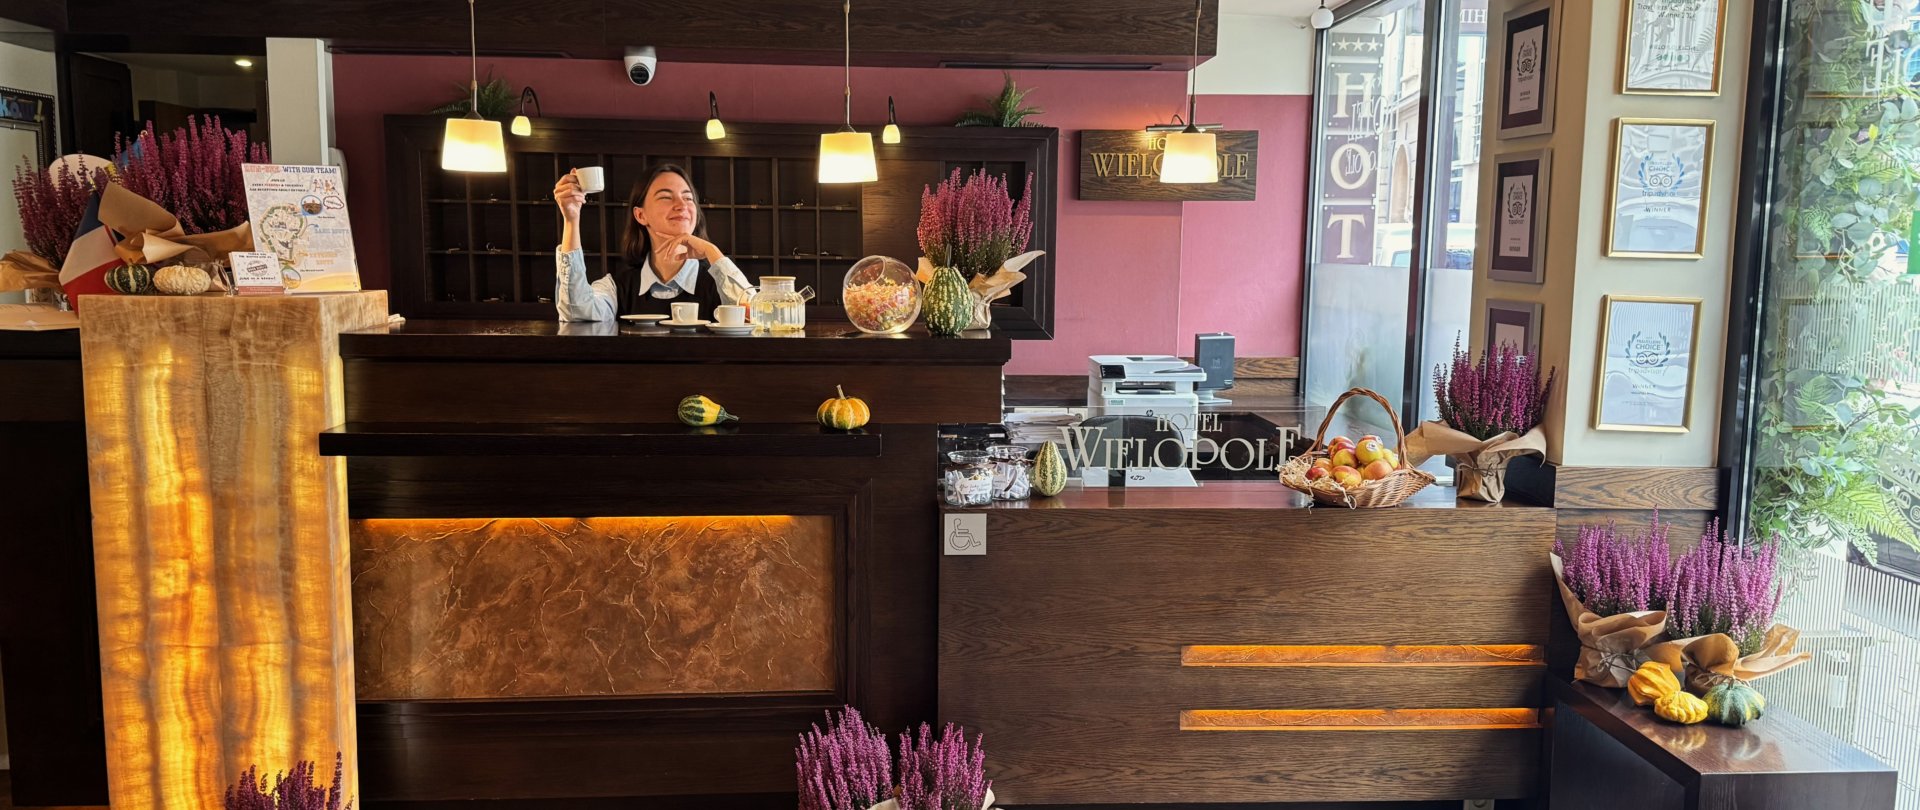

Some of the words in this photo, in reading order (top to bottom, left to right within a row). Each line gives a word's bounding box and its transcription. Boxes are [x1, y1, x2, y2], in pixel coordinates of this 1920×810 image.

[316, 166, 337, 174] TEAM!
[1635, 343, 1661, 351] CHOICE
[1154, 412, 1223, 433] HOTEL
[1057, 424, 1302, 472] WIELOPOLE
